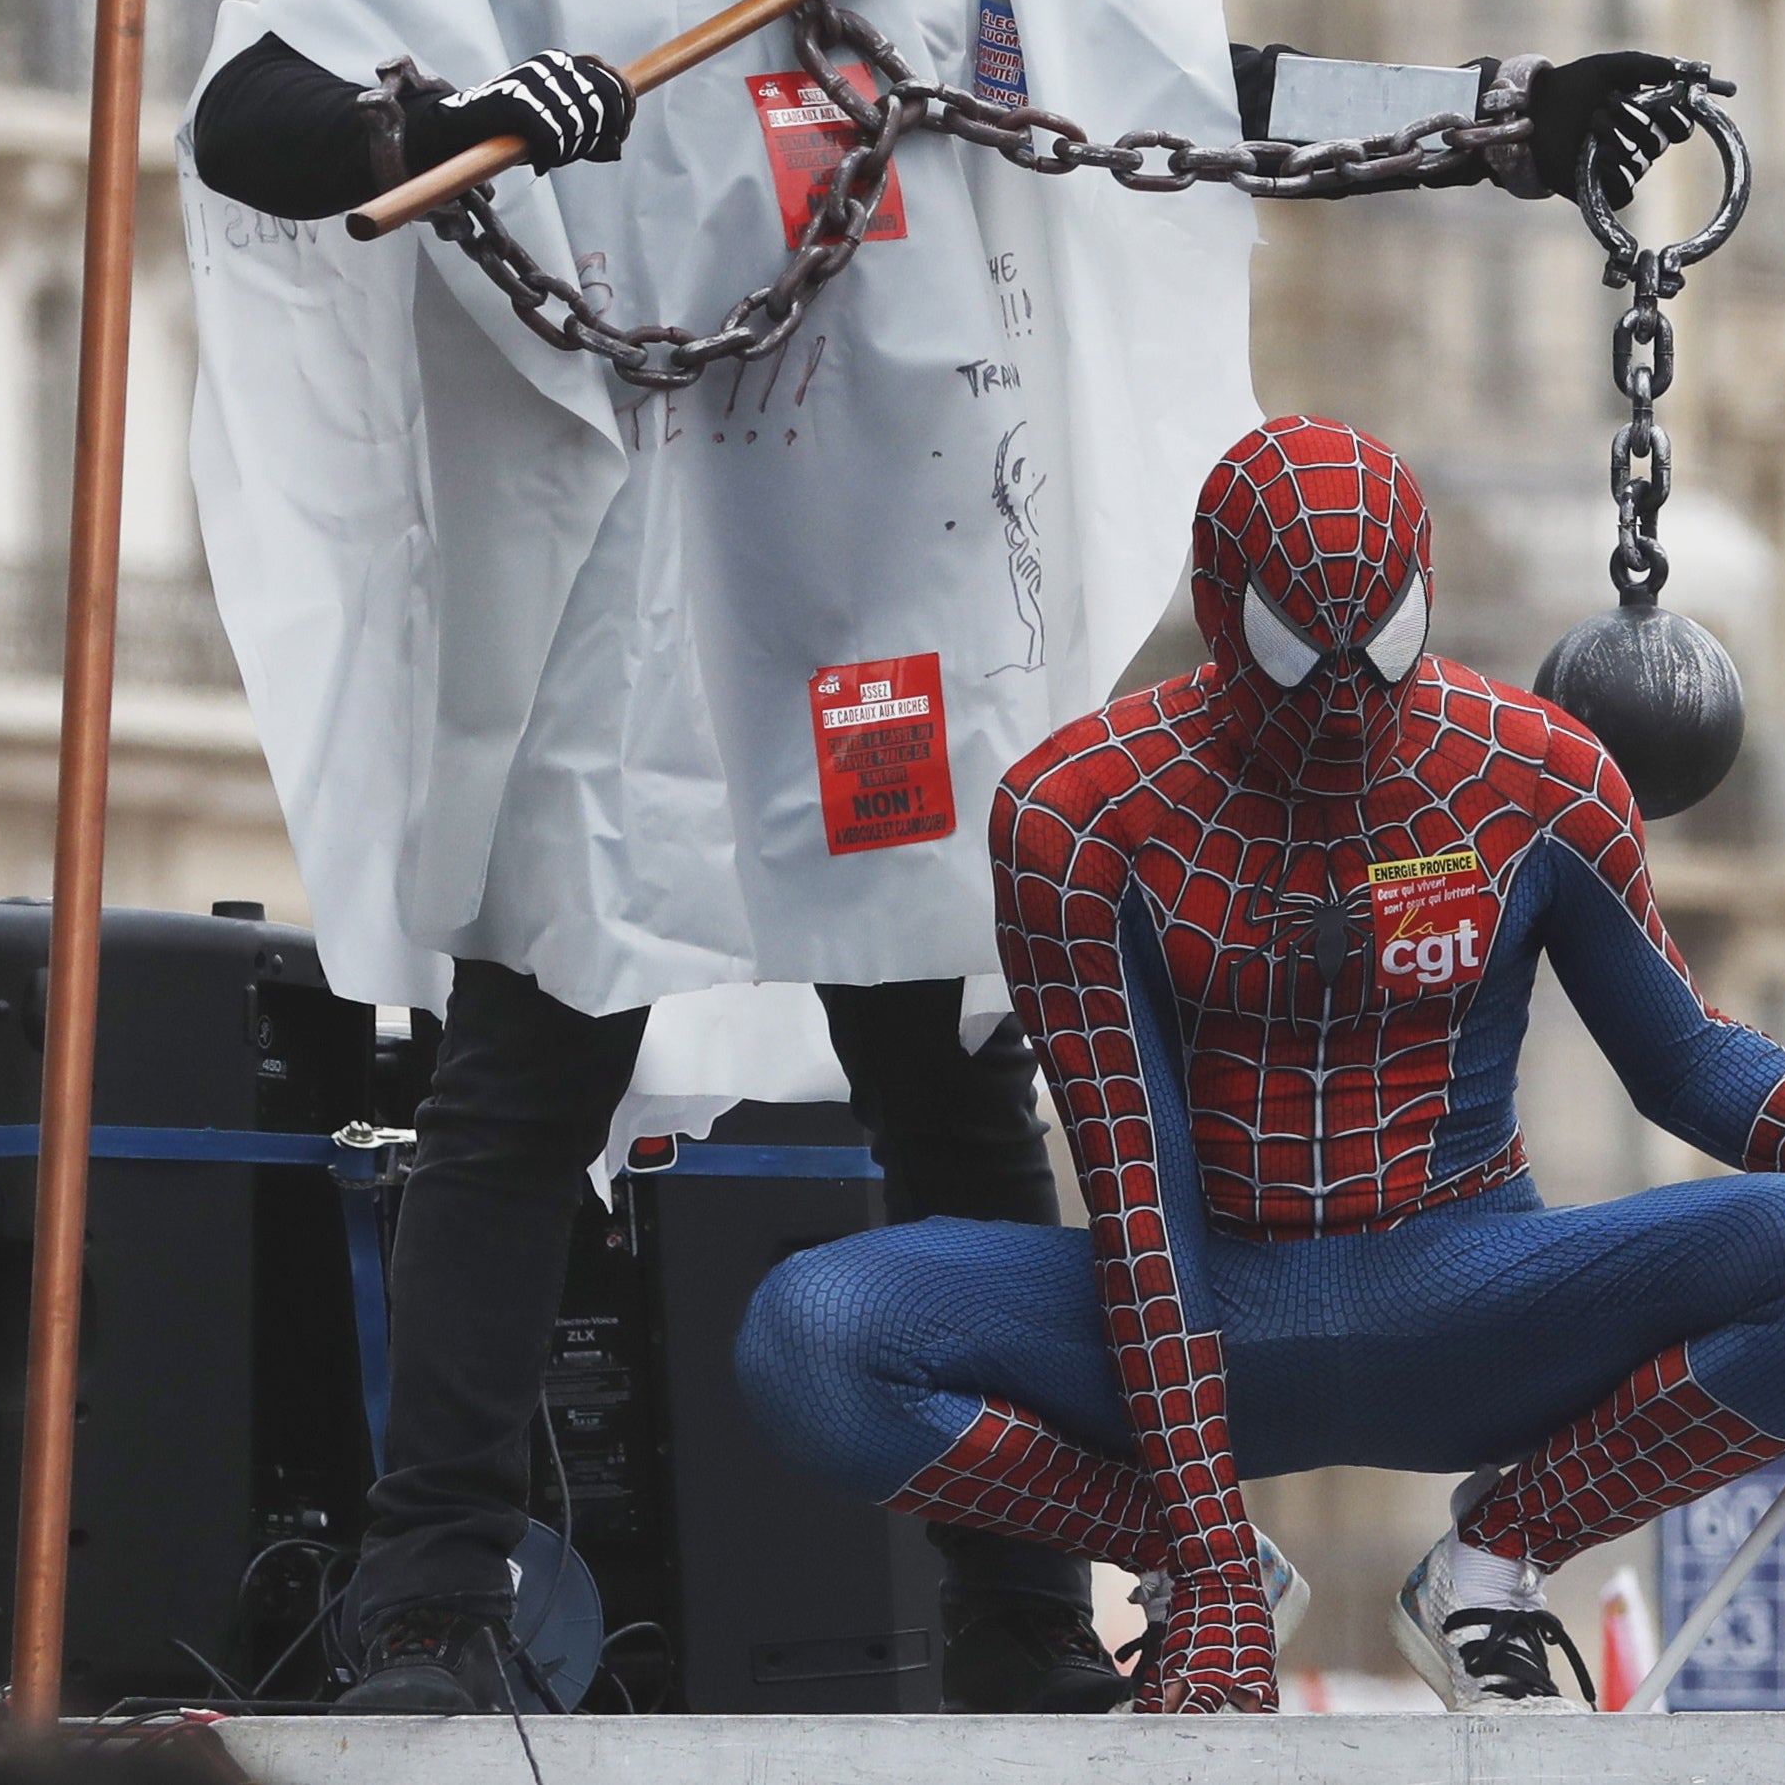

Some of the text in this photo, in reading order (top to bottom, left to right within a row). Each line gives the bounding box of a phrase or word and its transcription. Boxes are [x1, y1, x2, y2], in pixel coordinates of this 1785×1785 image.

[781, 108, 819, 124] CADEAUX
[818, 681, 841, 694] cgt
[860, 683, 889, 701] ASSEZ
[823, 697, 929, 726] DE CADEAUX AUX RICHES
[852, 786, 925, 821] NON !
[1374, 855, 1473, 882] ENERGIE PROVENCE
[1377, 876, 1447, 901] Ceux qui vivent
[1383, 884, 1476, 915] sont ceux qui luttent
[1381, 918, 1479, 984] cgt
[566, 1329, 596, 1343] ZLX
